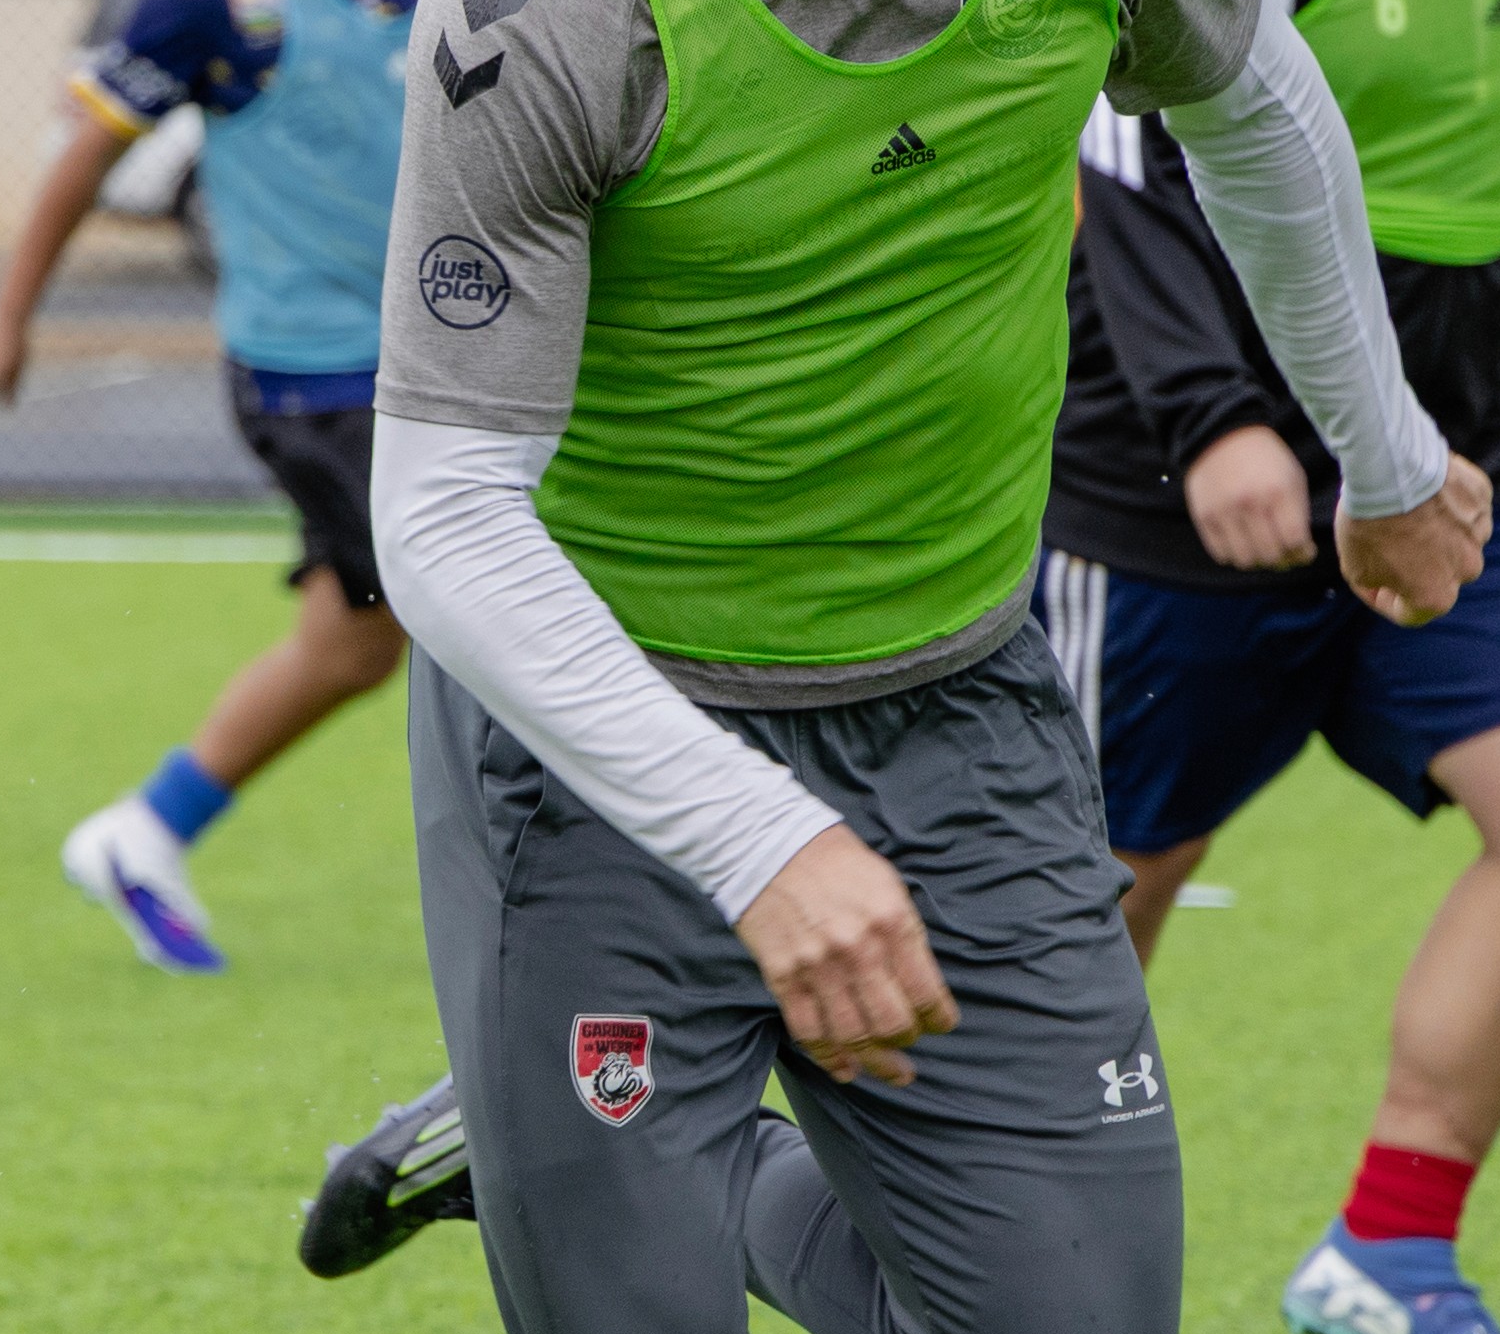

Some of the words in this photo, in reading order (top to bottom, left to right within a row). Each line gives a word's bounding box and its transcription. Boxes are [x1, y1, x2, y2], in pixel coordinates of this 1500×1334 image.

[871, 148, 936, 175] adidas
[430, 254, 484, 283] just
[432, 279, 503, 308] play
[582, 1023, 645, 1038] GARDNER
[1101, 1112, 1134, 1124] UNDER
